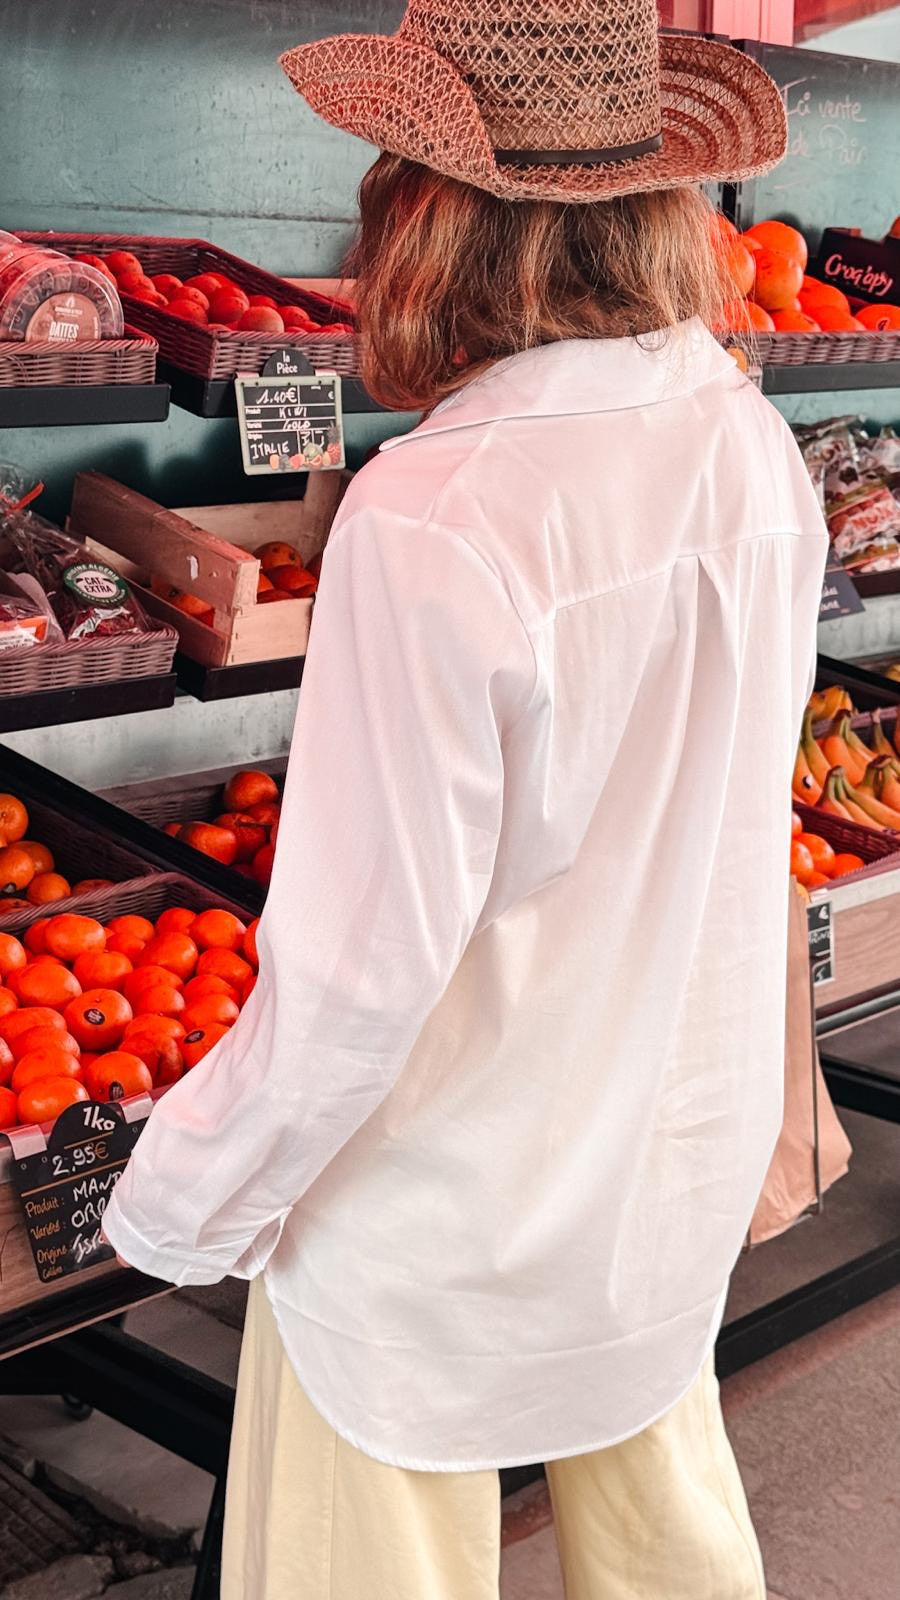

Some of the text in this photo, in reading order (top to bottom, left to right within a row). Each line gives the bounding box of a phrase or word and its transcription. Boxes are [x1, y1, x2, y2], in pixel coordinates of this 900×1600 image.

[818, 95, 866, 122] vente
[49, 321, 79, 339] DATTES
[282, 350, 290, 363] la
[276, 362, 298, 374] Pièce
[279, 407, 307, 418] KIWI
[250, 441, 290, 460] ITALIE
[84, 576, 104, 586] CAT.
[83, 584, 113, 593] EXTRA
